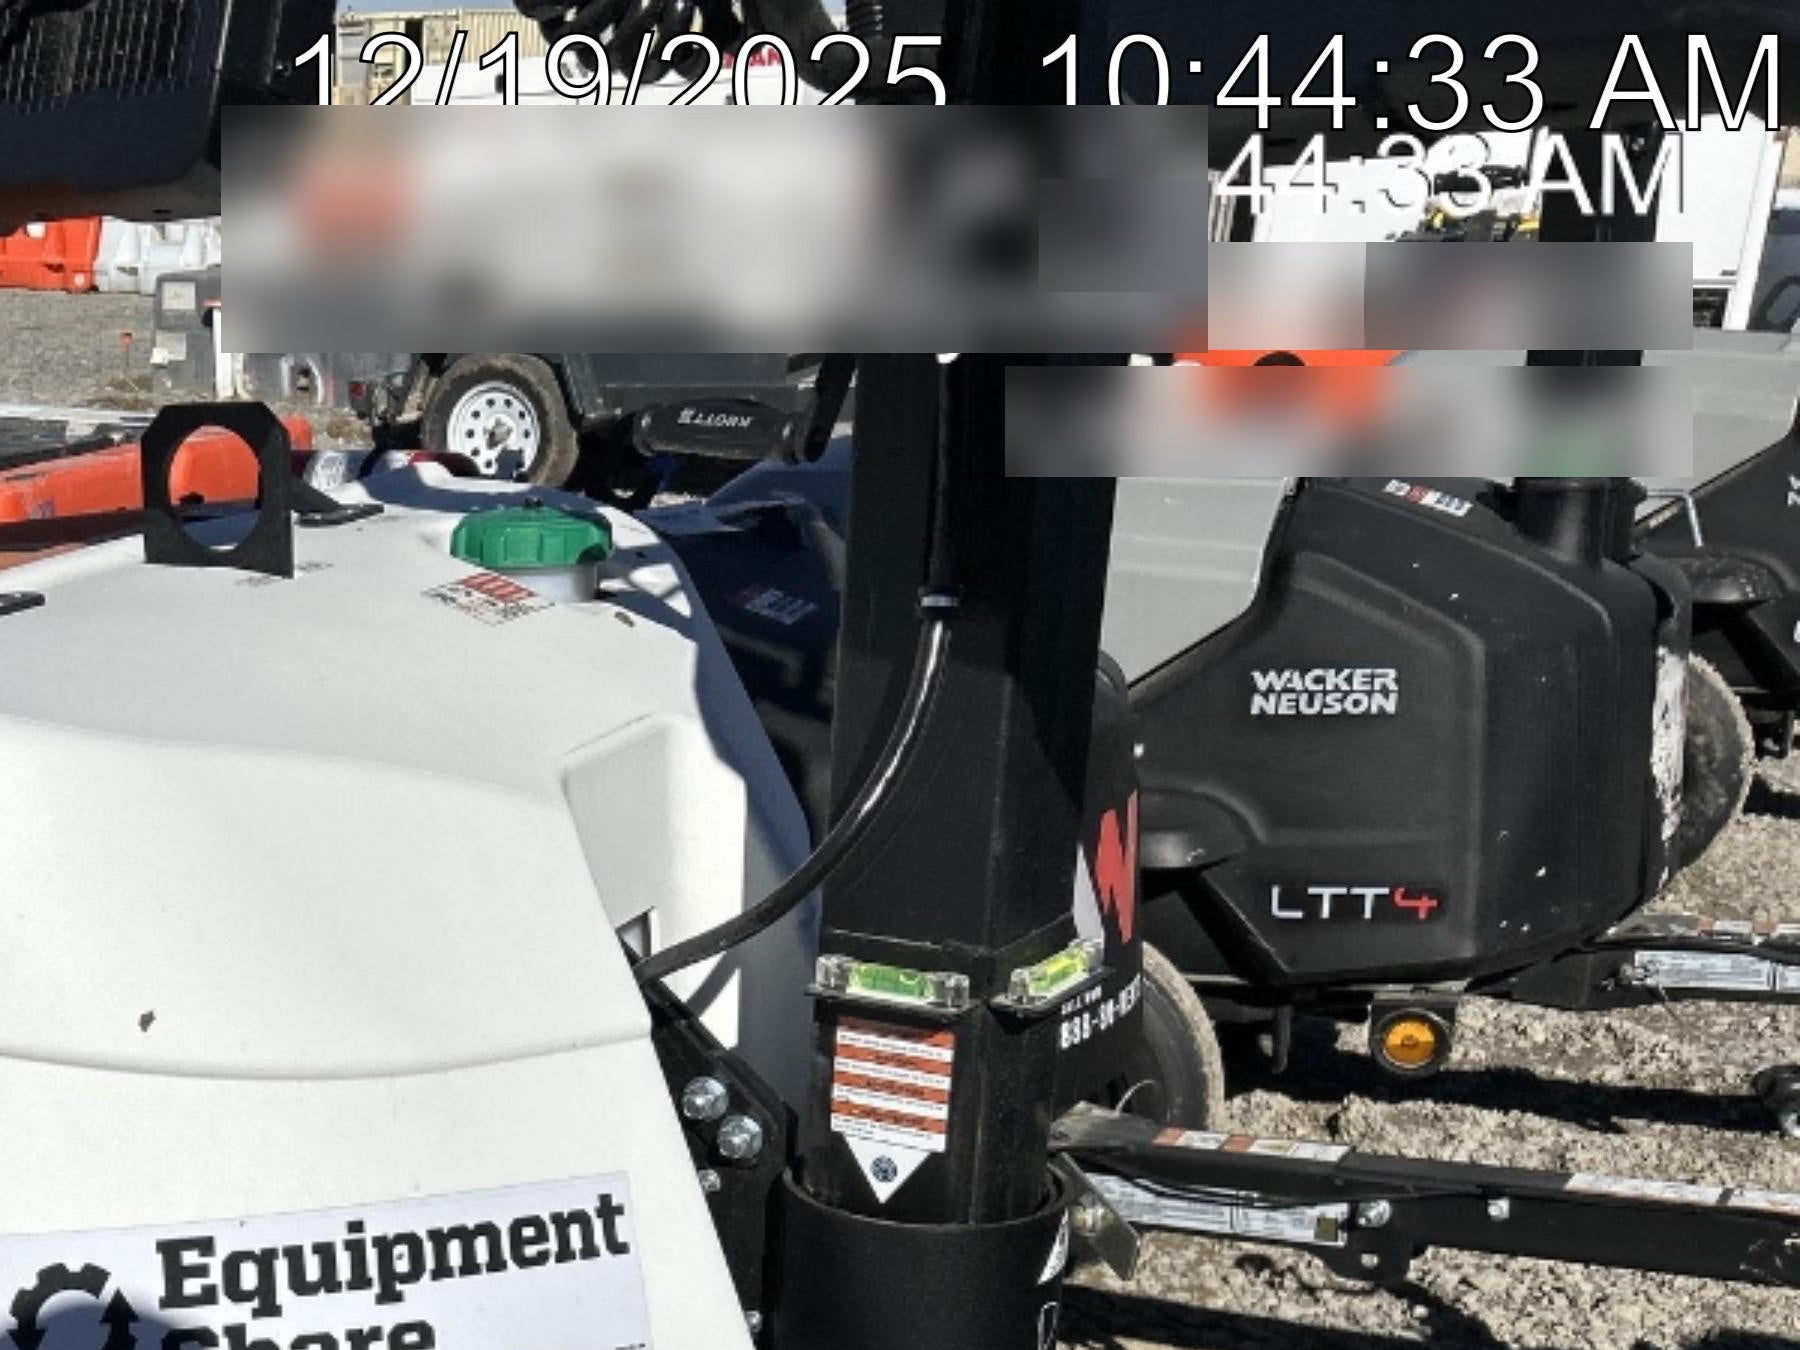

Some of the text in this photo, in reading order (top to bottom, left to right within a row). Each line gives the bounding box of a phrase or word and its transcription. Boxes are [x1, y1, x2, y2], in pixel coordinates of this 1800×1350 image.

[1249, 667, 1399, 692] WACKER
[1249, 691, 1399, 716] NEUSON
[1270, 884, 1439, 921] LTT4
[155, 1191, 631, 1319] Equipment
